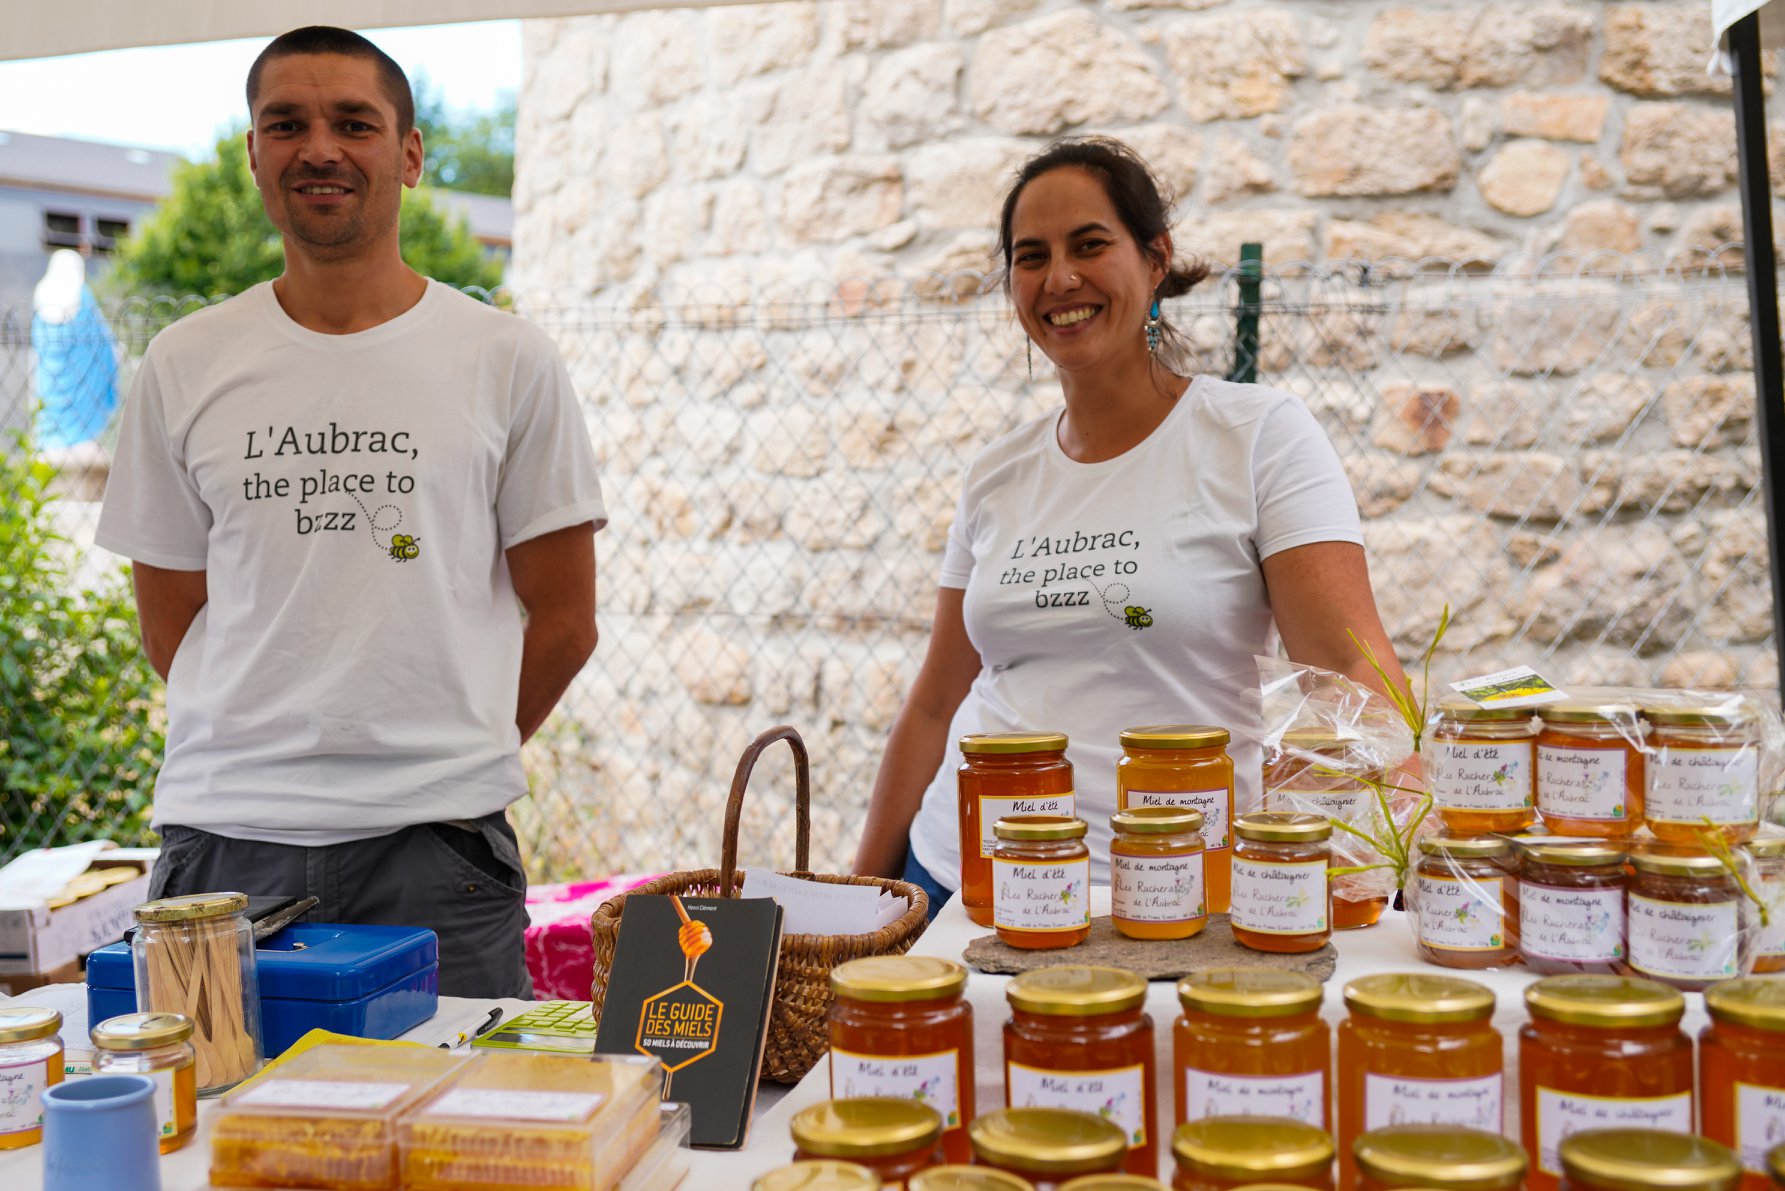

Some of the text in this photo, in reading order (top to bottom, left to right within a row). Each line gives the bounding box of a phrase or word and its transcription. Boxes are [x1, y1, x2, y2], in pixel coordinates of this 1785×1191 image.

[244, 422, 418, 460] L'Aubrac,
[243, 469, 415, 504] the place to
[294, 508, 357, 535] bzzz
[1010, 530, 1140, 559] L'Aubrac,
[999, 559, 1138, 587] the place to
[1035, 590, 1090, 608] bzzz
[1473, 747, 1500, 760] d'été
[1556, 753, 1601, 770] montagne
[1671, 756, 1682, 767] de
[1012, 799, 1059, 813] Miel d'été
[1142, 795, 1215, 809] Miel de montagne
[1012, 866, 1066, 880] Miel d'été
[1115, 858, 1189, 876] Miel de montagne
[1247, 868, 1257, 879] de
[1137, 880, 1174, 893] Ruchers
[1437, 884, 1461, 897] d'été
[1133, 899, 1142, 907] de
[1540, 893, 1551, 904] de
[1556, 895, 1602, 911] montagne
[1022, 906, 1031, 915] de
[648, 1001, 716, 1021] LE GUIDE
[645, 1019, 713, 1037] DES MIELS
[642, 1037, 710, 1050] 50 MIELS À DÉCOUVRIR
